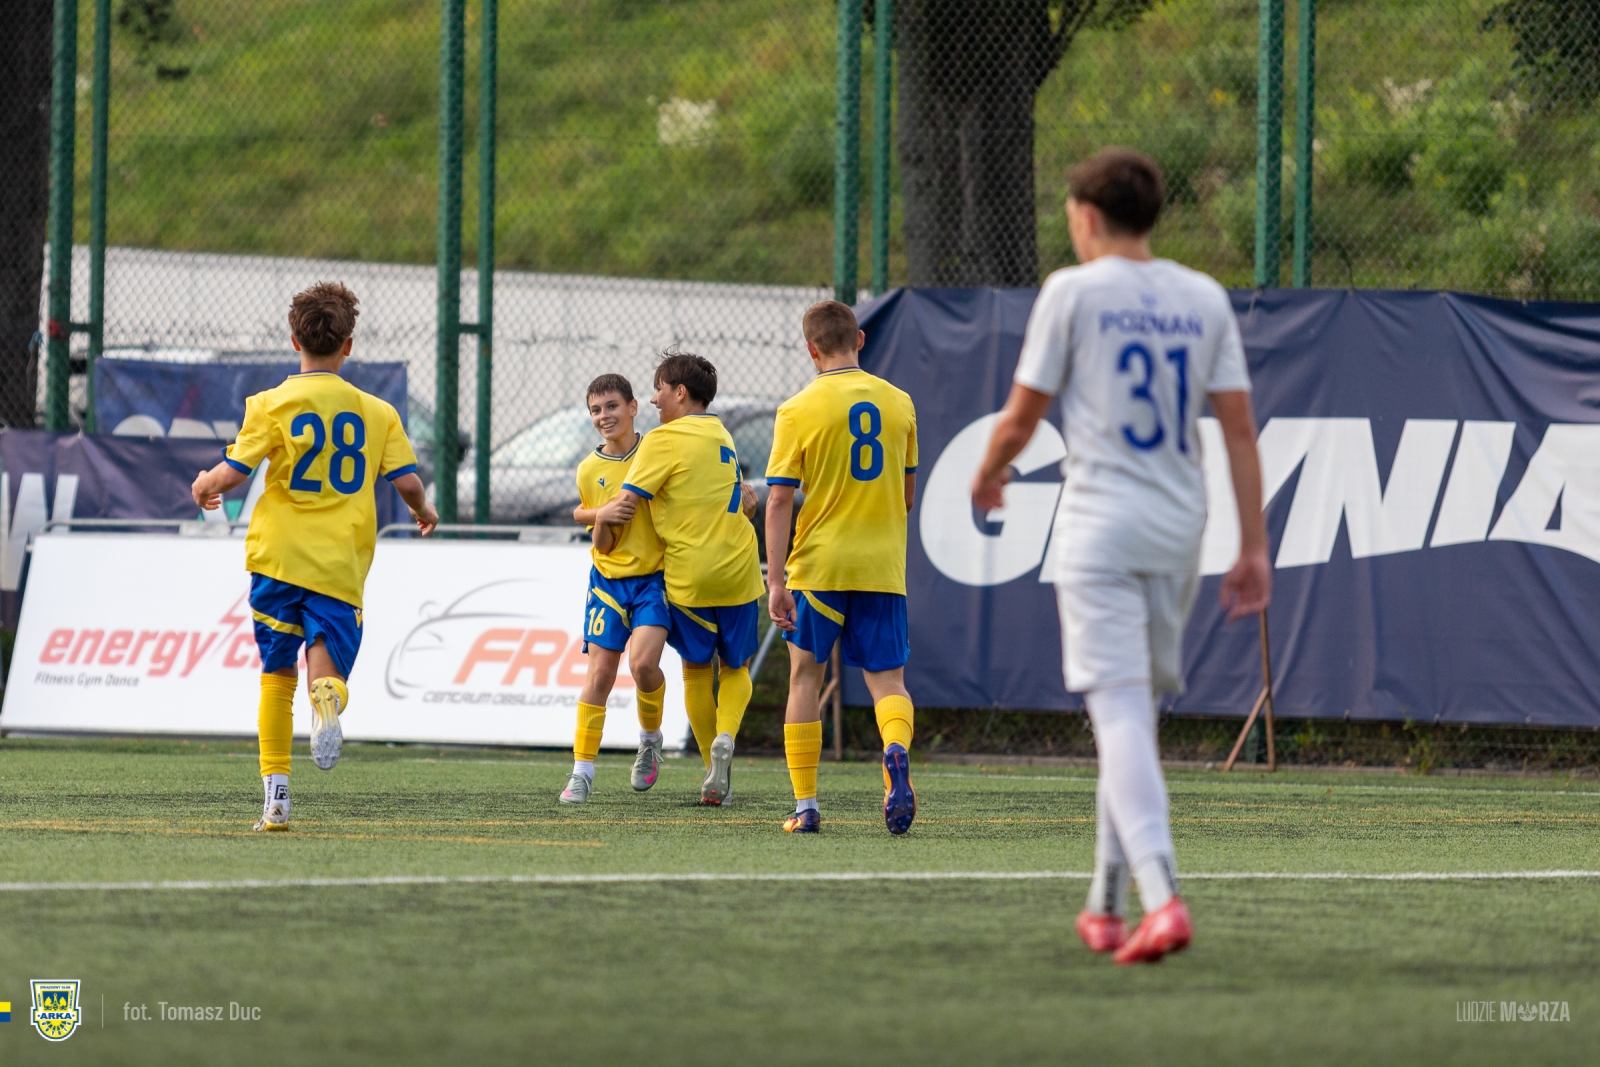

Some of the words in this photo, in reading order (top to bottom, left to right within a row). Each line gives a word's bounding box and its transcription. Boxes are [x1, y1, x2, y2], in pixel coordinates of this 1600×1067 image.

[1117, 341, 1189, 454] 31
[289, 411, 366, 494] 28
[849, 401, 883, 481] 8
[720, 446, 741, 513] 7
[39, 629, 219, 678] energy
[587, 607, 605, 636] 16
[35, 671, 75, 686] Fitness
[77, 672, 102, 688] Gym
[104, 673, 139, 687] Dance
